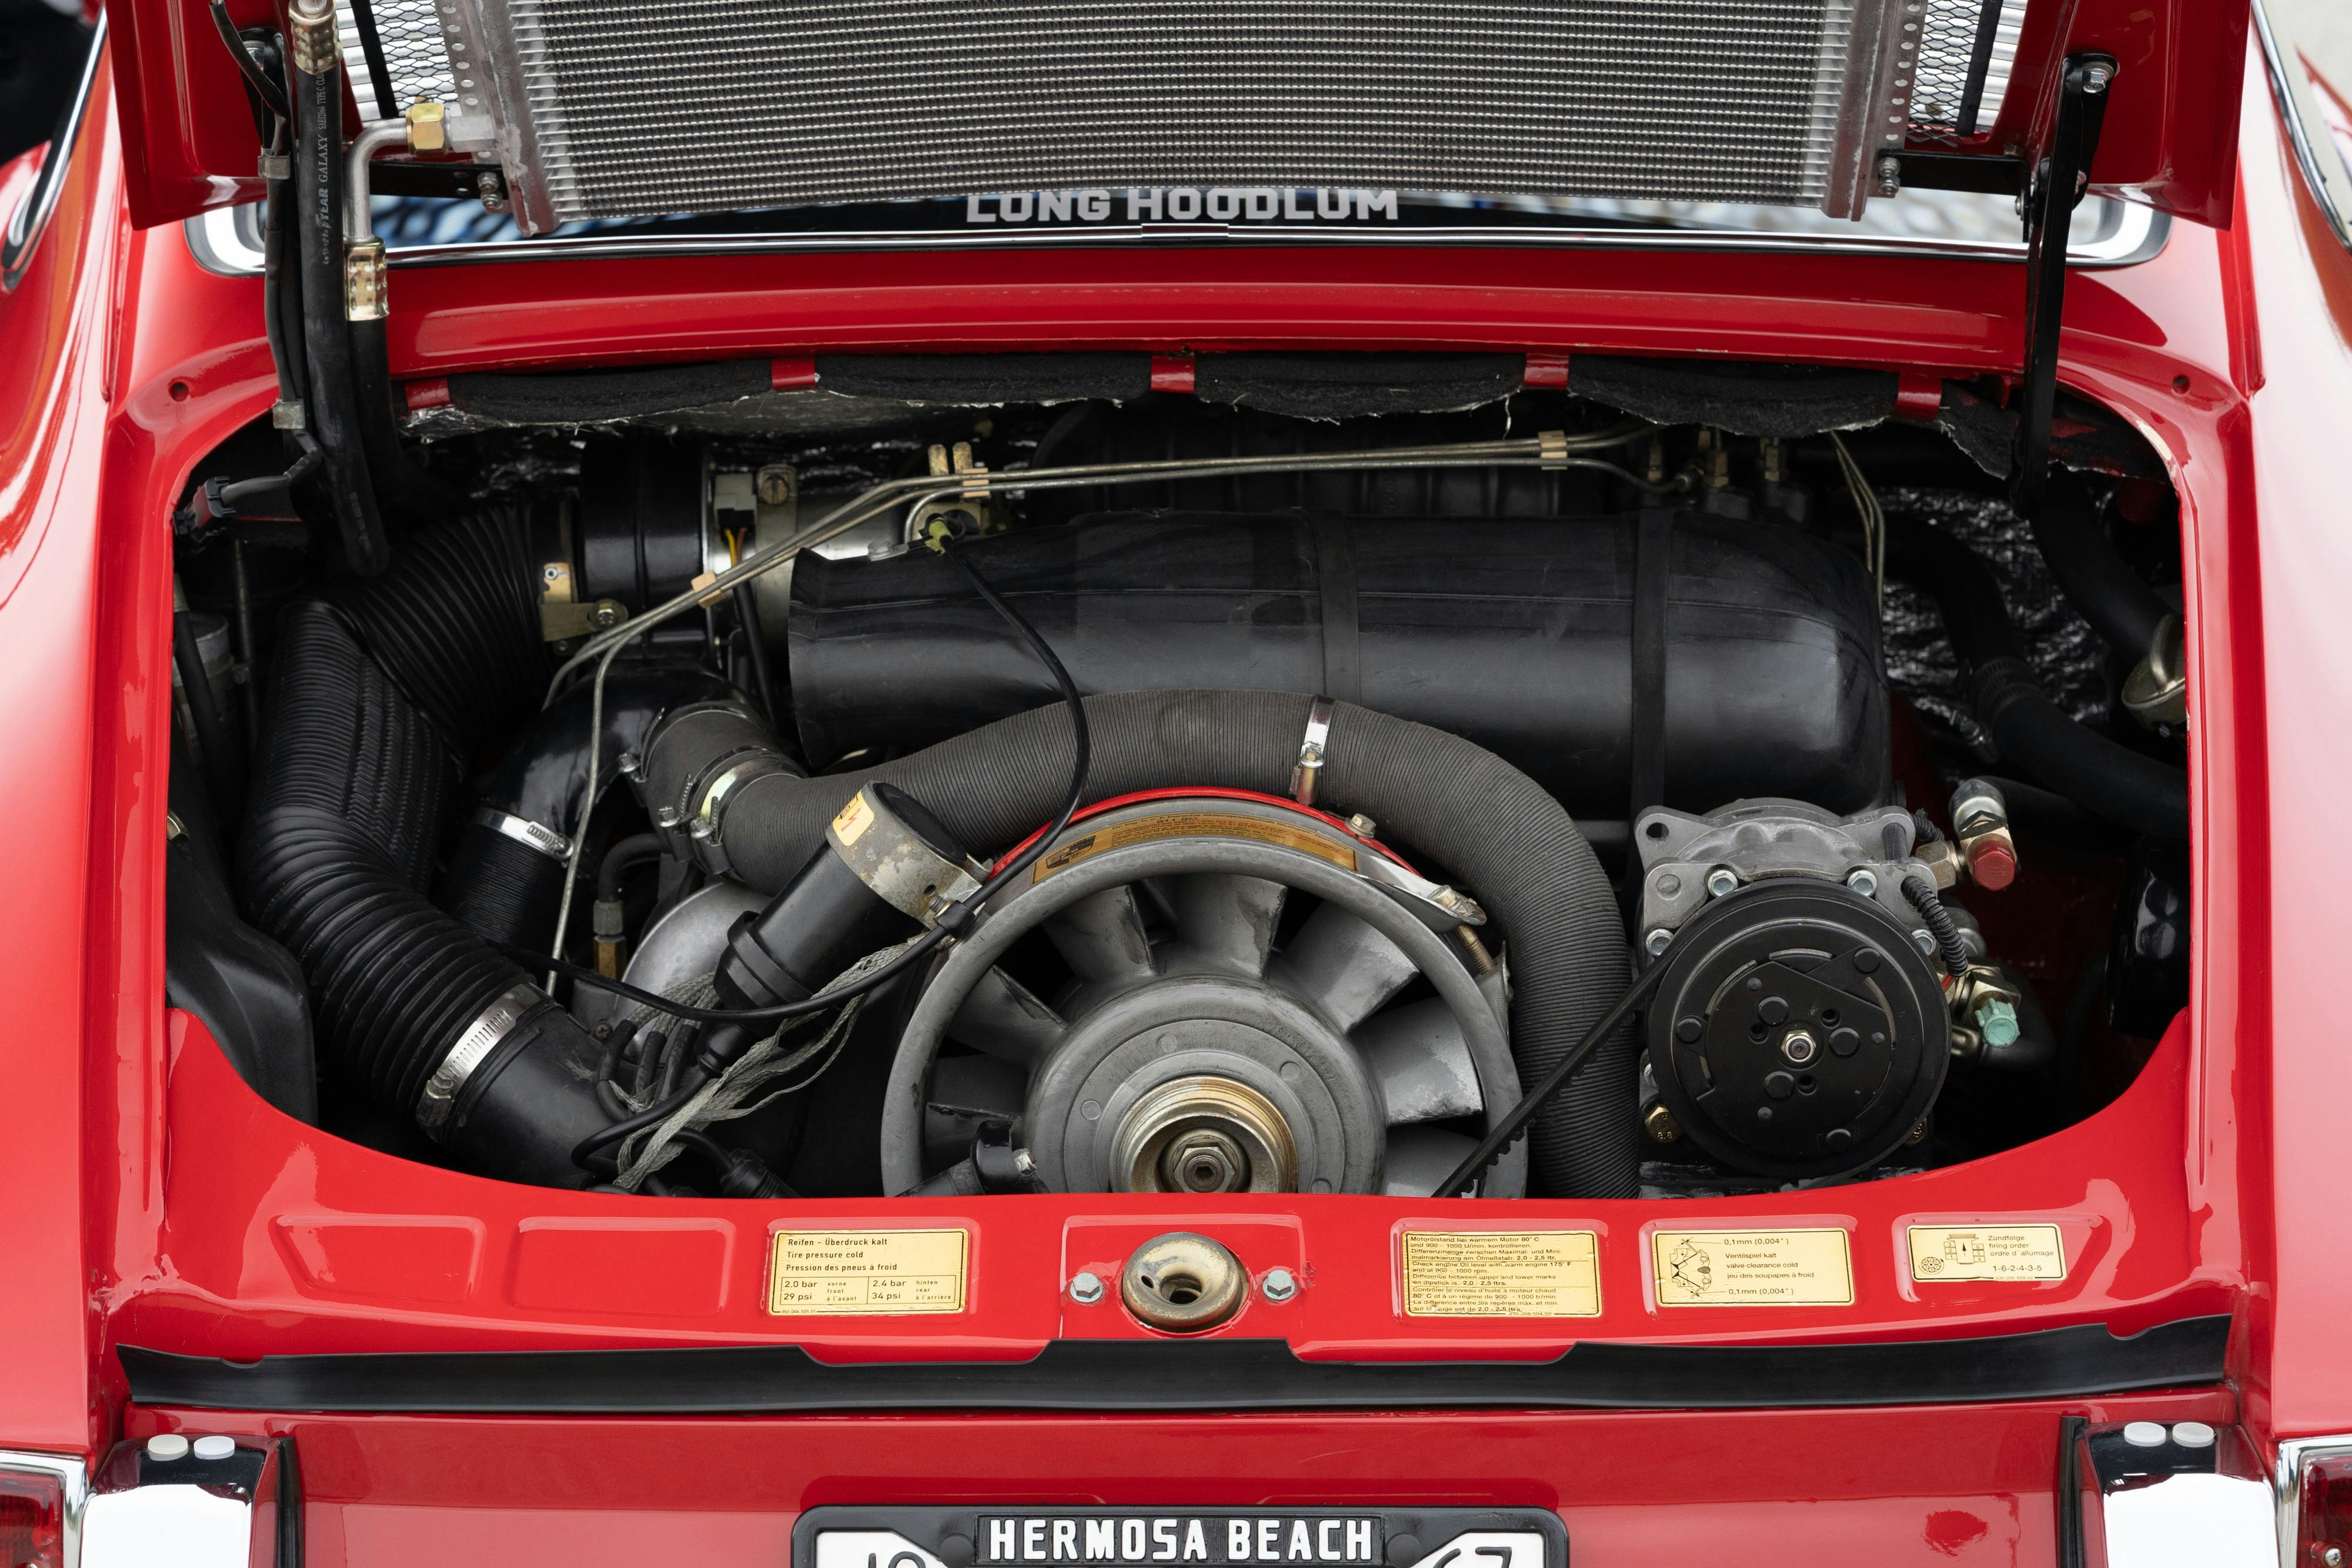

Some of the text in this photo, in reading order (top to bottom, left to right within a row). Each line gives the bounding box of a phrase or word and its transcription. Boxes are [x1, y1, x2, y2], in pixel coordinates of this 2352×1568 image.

[318, 134, 328, 182] GALAXY
[966, 189, 1398, 222] LONG HOODLUM
[798, 1293, 812, 1302] psi
[887, 1292, 900, 1300] psi
[989, 1519, 1372, 1560] HERMOSA BEACH
